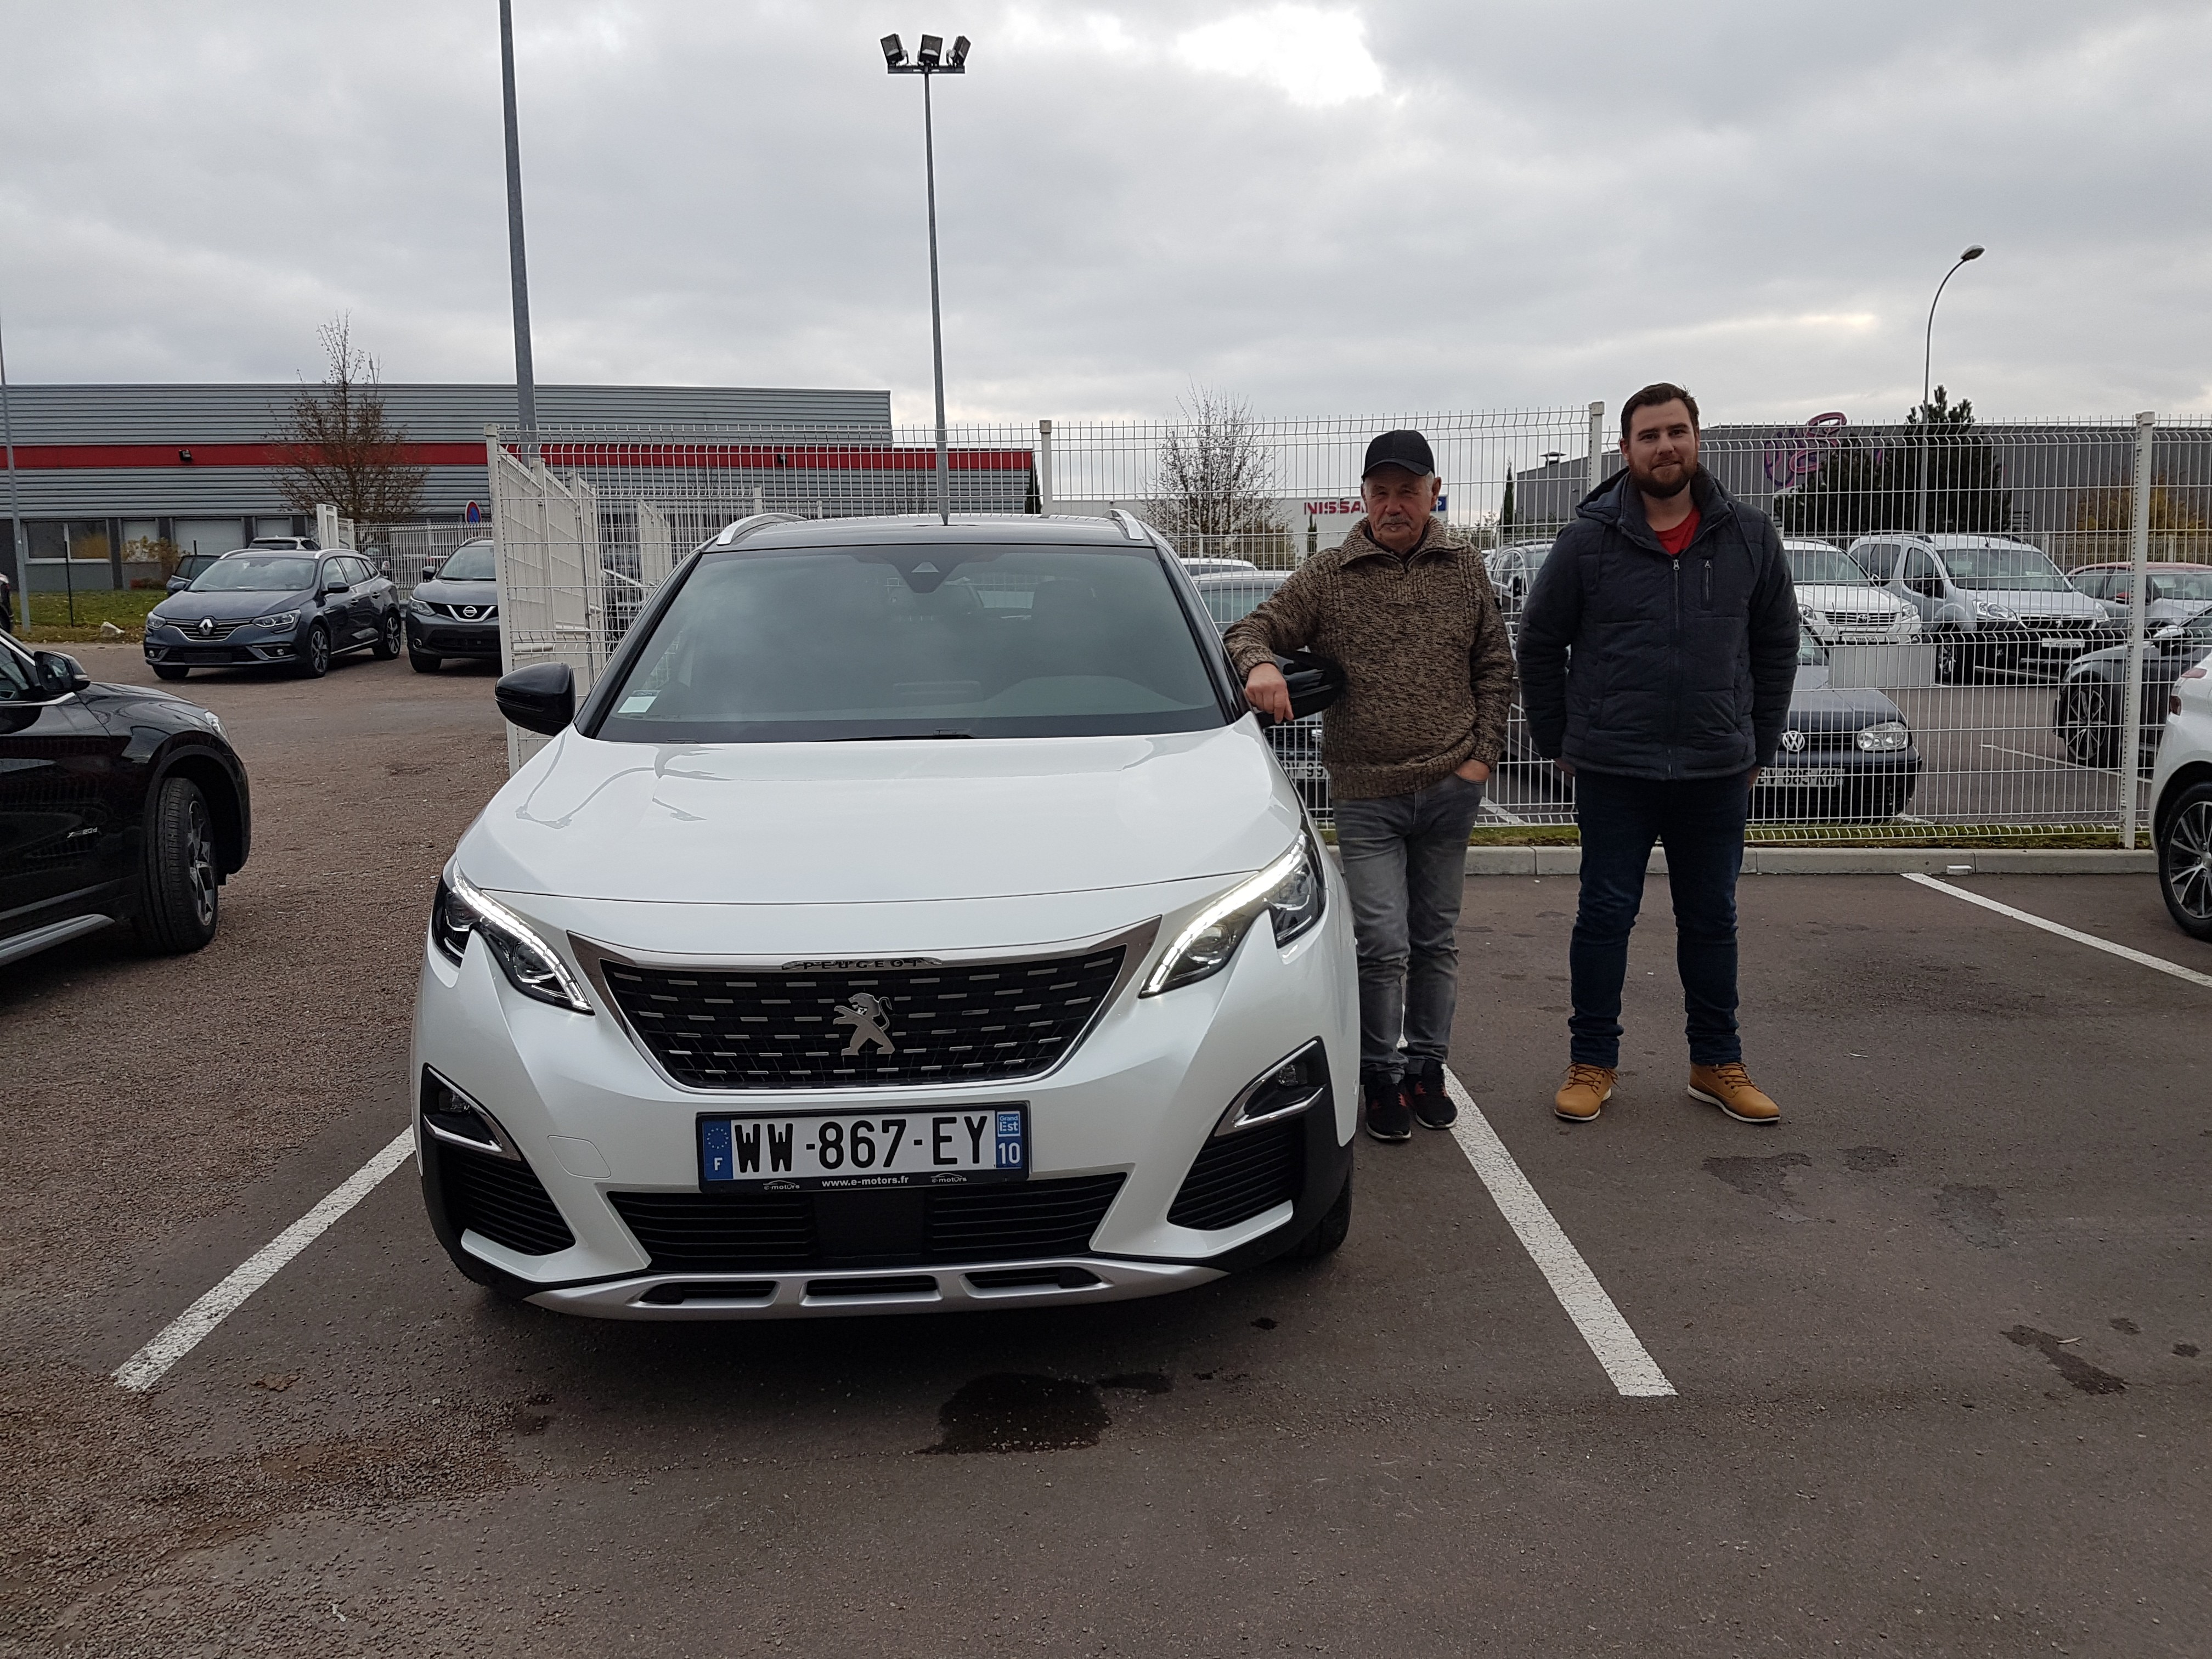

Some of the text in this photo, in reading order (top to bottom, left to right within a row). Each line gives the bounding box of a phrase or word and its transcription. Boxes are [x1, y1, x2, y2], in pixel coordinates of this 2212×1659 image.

[1304, 501, 1369, 515] NISSA
[803, 960, 923, 970] PEUGEOT
[999, 1121, 1018, 1131] Est
[735, 1116, 988, 1173] WW-867-EY
[998, 1142, 1020, 1164] 10
[714, 1157, 723, 1171] F
[821, 1176, 909, 1187] www.e-motors.fr
